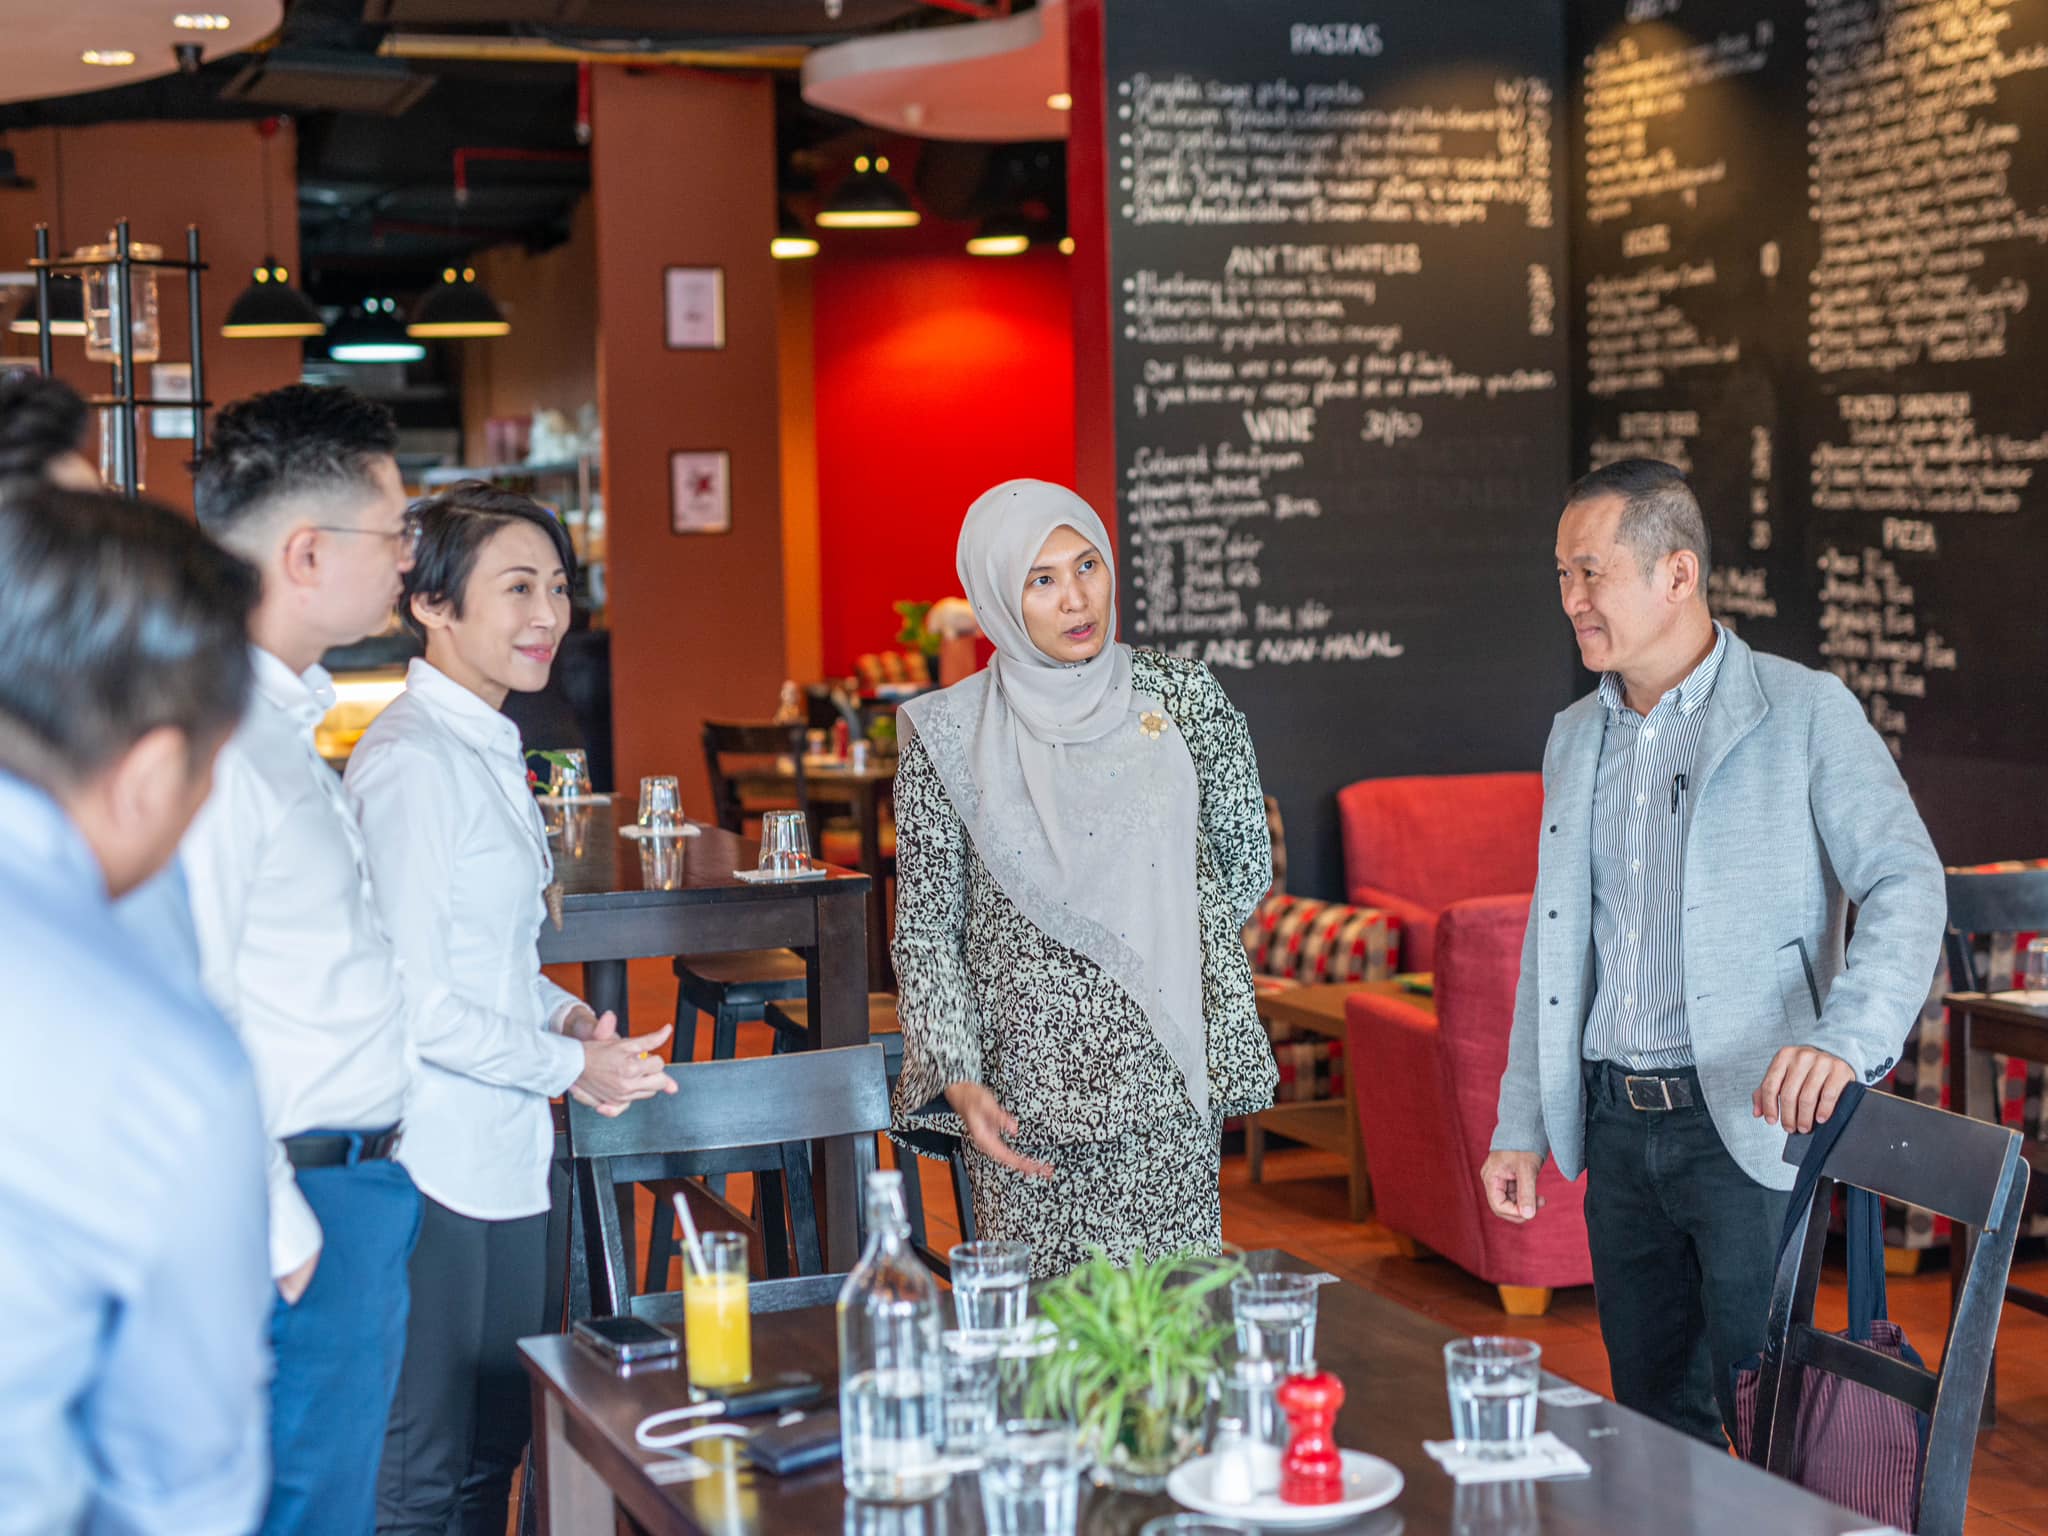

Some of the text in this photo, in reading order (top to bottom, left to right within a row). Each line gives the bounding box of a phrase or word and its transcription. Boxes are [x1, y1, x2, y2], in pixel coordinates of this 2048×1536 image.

[1290, 22, 1382, 55] PASTAS
[1225, 246, 1280, 275] ANY
[1243, 406, 1316, 443] WINE
[1883, 516, 1937, 552] PIZZA
[1203, 638, 1254, 669] ARE
[1255, 630, 1405, 668] NON-HALAL
